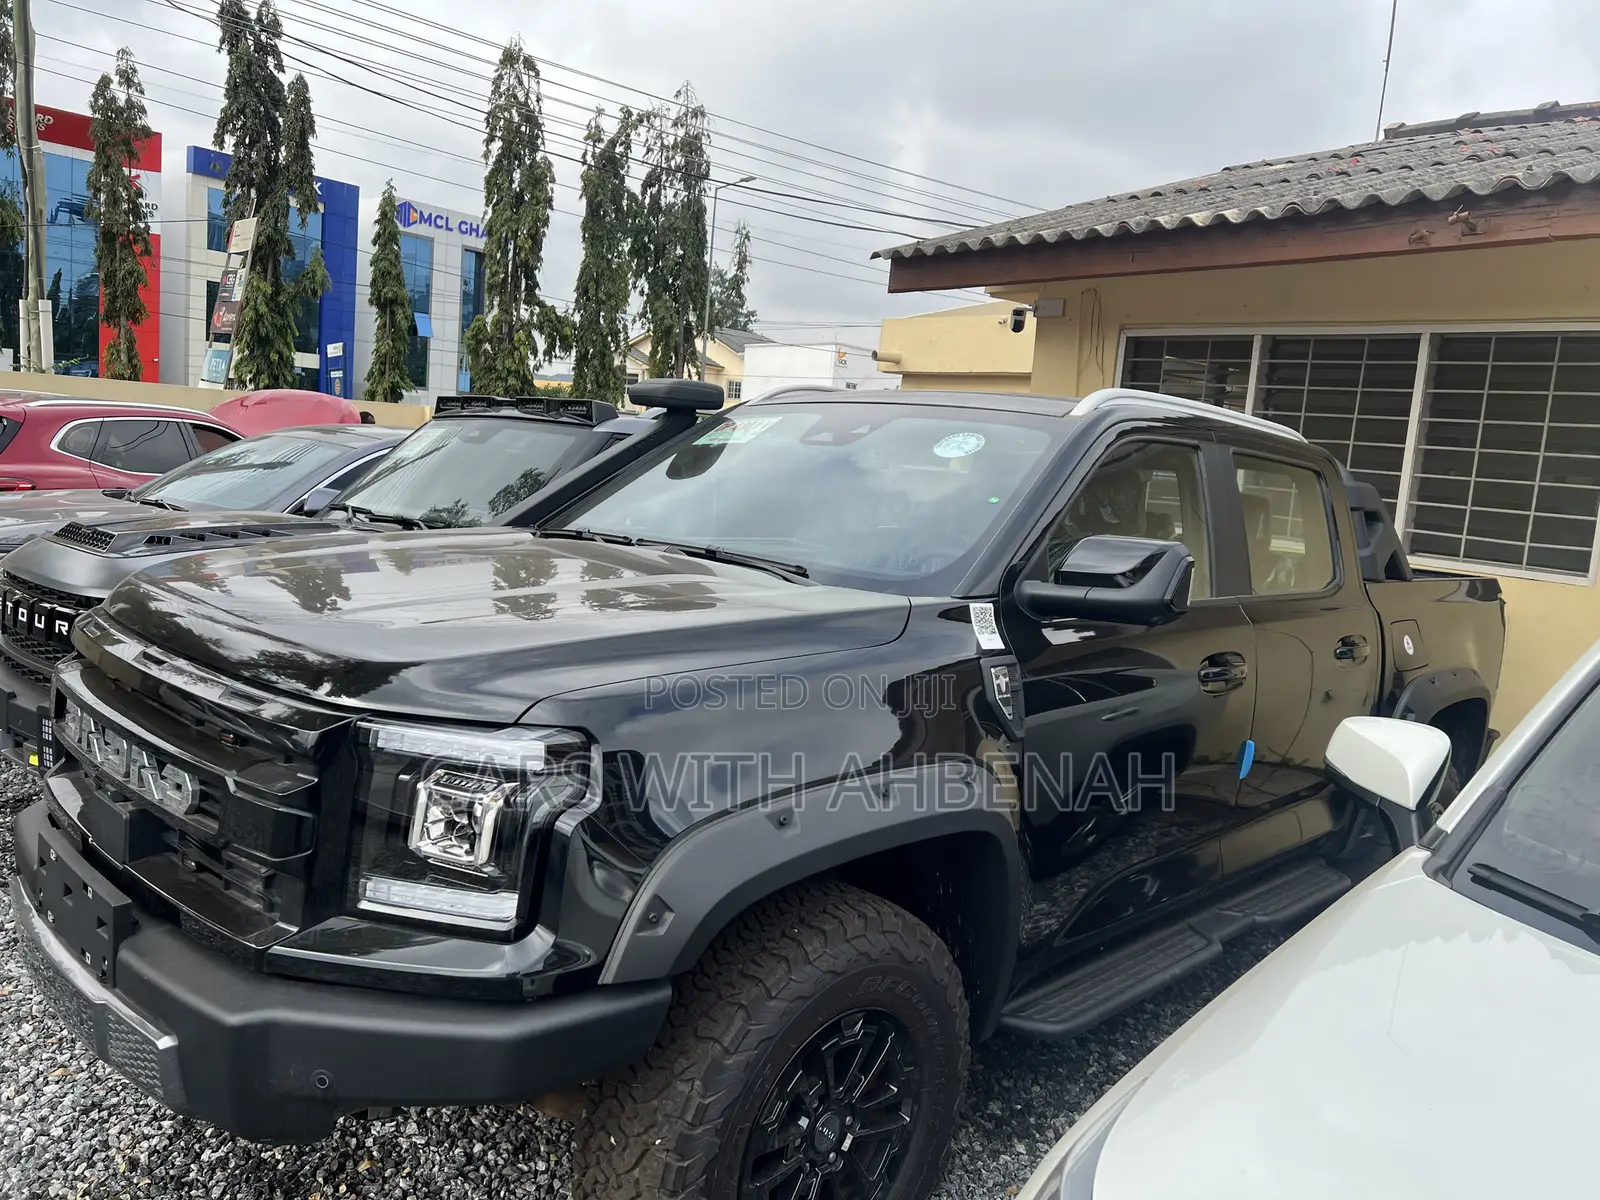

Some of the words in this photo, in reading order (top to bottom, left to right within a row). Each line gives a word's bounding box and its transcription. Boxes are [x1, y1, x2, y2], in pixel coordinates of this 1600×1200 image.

[418, 209, 454, 232] MCL
[458, 220, 489, 239] GHA
[0, 597, 69, 636] TOUR
